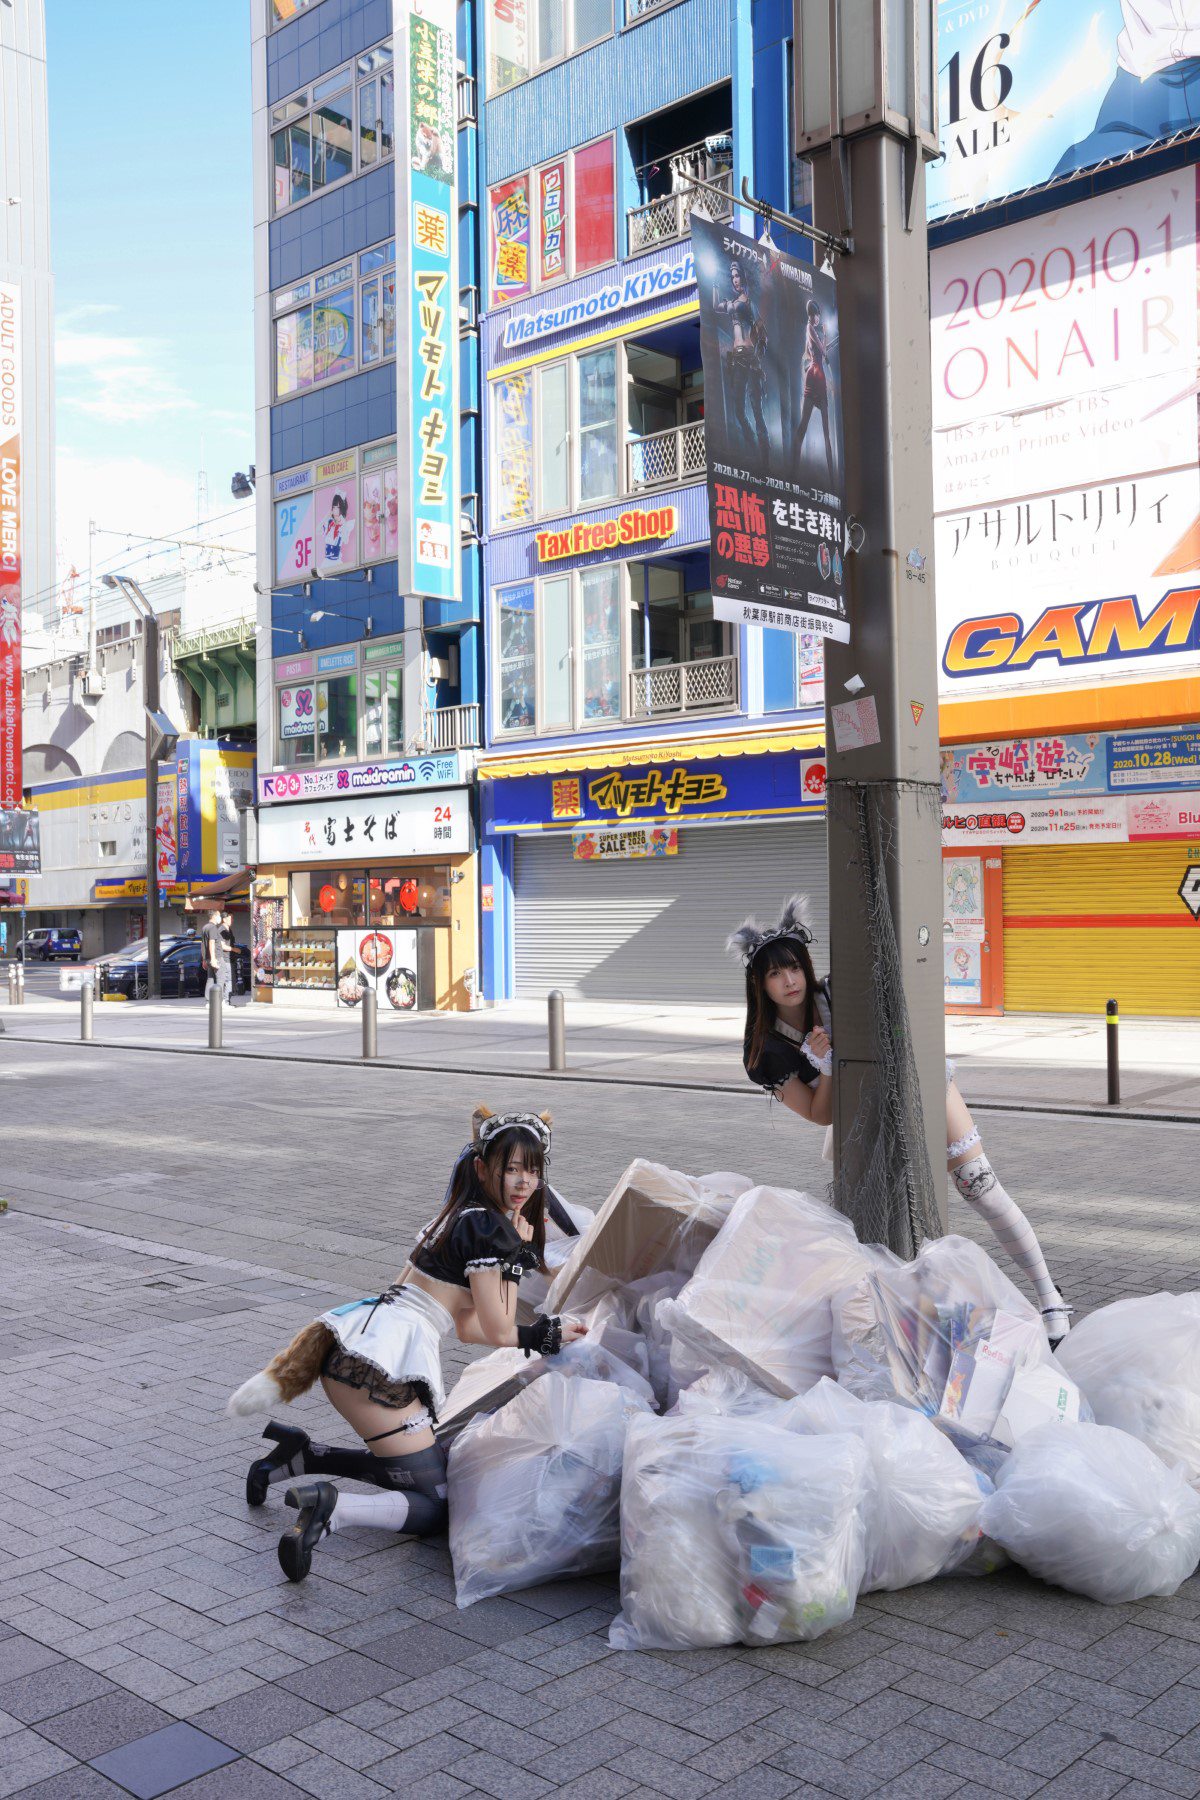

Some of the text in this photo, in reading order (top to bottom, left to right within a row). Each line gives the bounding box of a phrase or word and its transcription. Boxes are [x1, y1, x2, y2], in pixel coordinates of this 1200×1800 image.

[417, 209, 445, 252] 薬
[506, 257, 697, 344] Matsumoto KiYosh
[0, 292, 16, 427] ADULT GOODS
[944, 416, 1134, 468] Amazon Prime Video
[278, 471, 310, 492] RESTAURANT
[1, 457, 17, 571] LOVE MERCI
[280, 505, 298, 538] 2F
[714, 482, 767, 537] 恐怖
[772, 498, 842, 543] を生き残れ
[946, 482, 1170, 559] アサルトリリィ
[536, 507, 674, 560] Tax Free Shop
[716, 531, 770, 568] の悪夢
[295, 536, 313, 569] 3F
[905, 568, 926, 584] 18-45
[286, 663, 301, 676] PASTA
[436, 760, 454, 769] Free
[622, 751, 682, 763] Matsumoto KiYoshi
[277, 780, 287, 793] 2F
[289, 779, 300, 791] 3F
[352, 764, 416, 788] maidreamin
[436, 769, 454, 780] WiFi
[553, 780, 579, 816] 薬
[591, 772, 722, 813] マツモトキヨシ
[323, 809, 401, 847] 富士そば
[433, 806, 452, 823] 24
[433, 825, 453, 840] 時間
[599, 830, 646, 842] SUPER SUMMER
[599, 839, 626, 854] SALE
[628, 836, 646, 846] 2020
